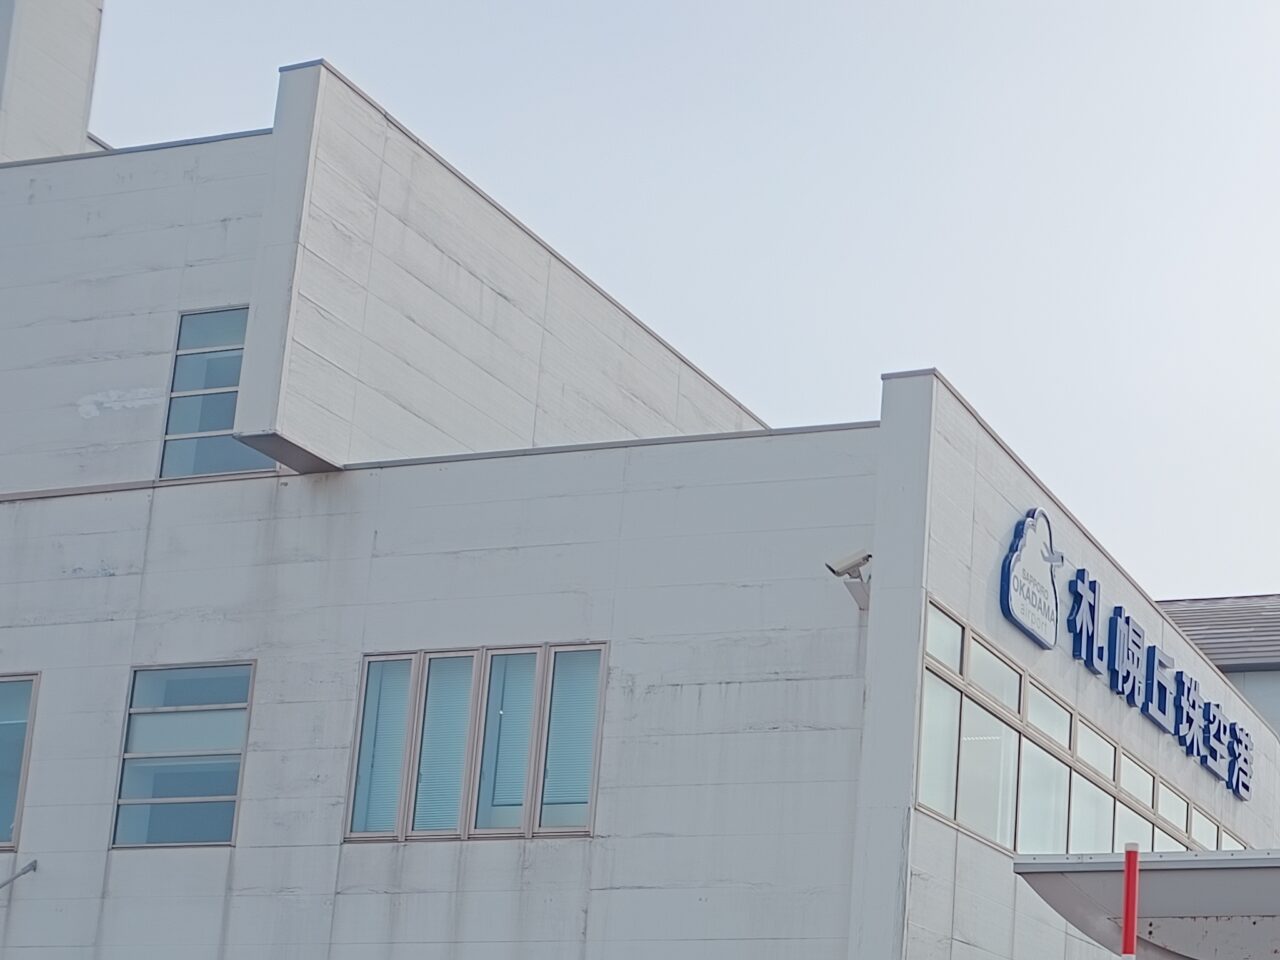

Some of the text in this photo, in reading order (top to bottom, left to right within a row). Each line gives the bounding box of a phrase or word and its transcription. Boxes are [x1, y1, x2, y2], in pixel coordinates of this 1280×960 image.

[1012, 574, 1055, 623] OKADAMA
[1020, 603, 1047, 634] airport
[1067, 568, 1254, 801] 札幌丘珠空港
